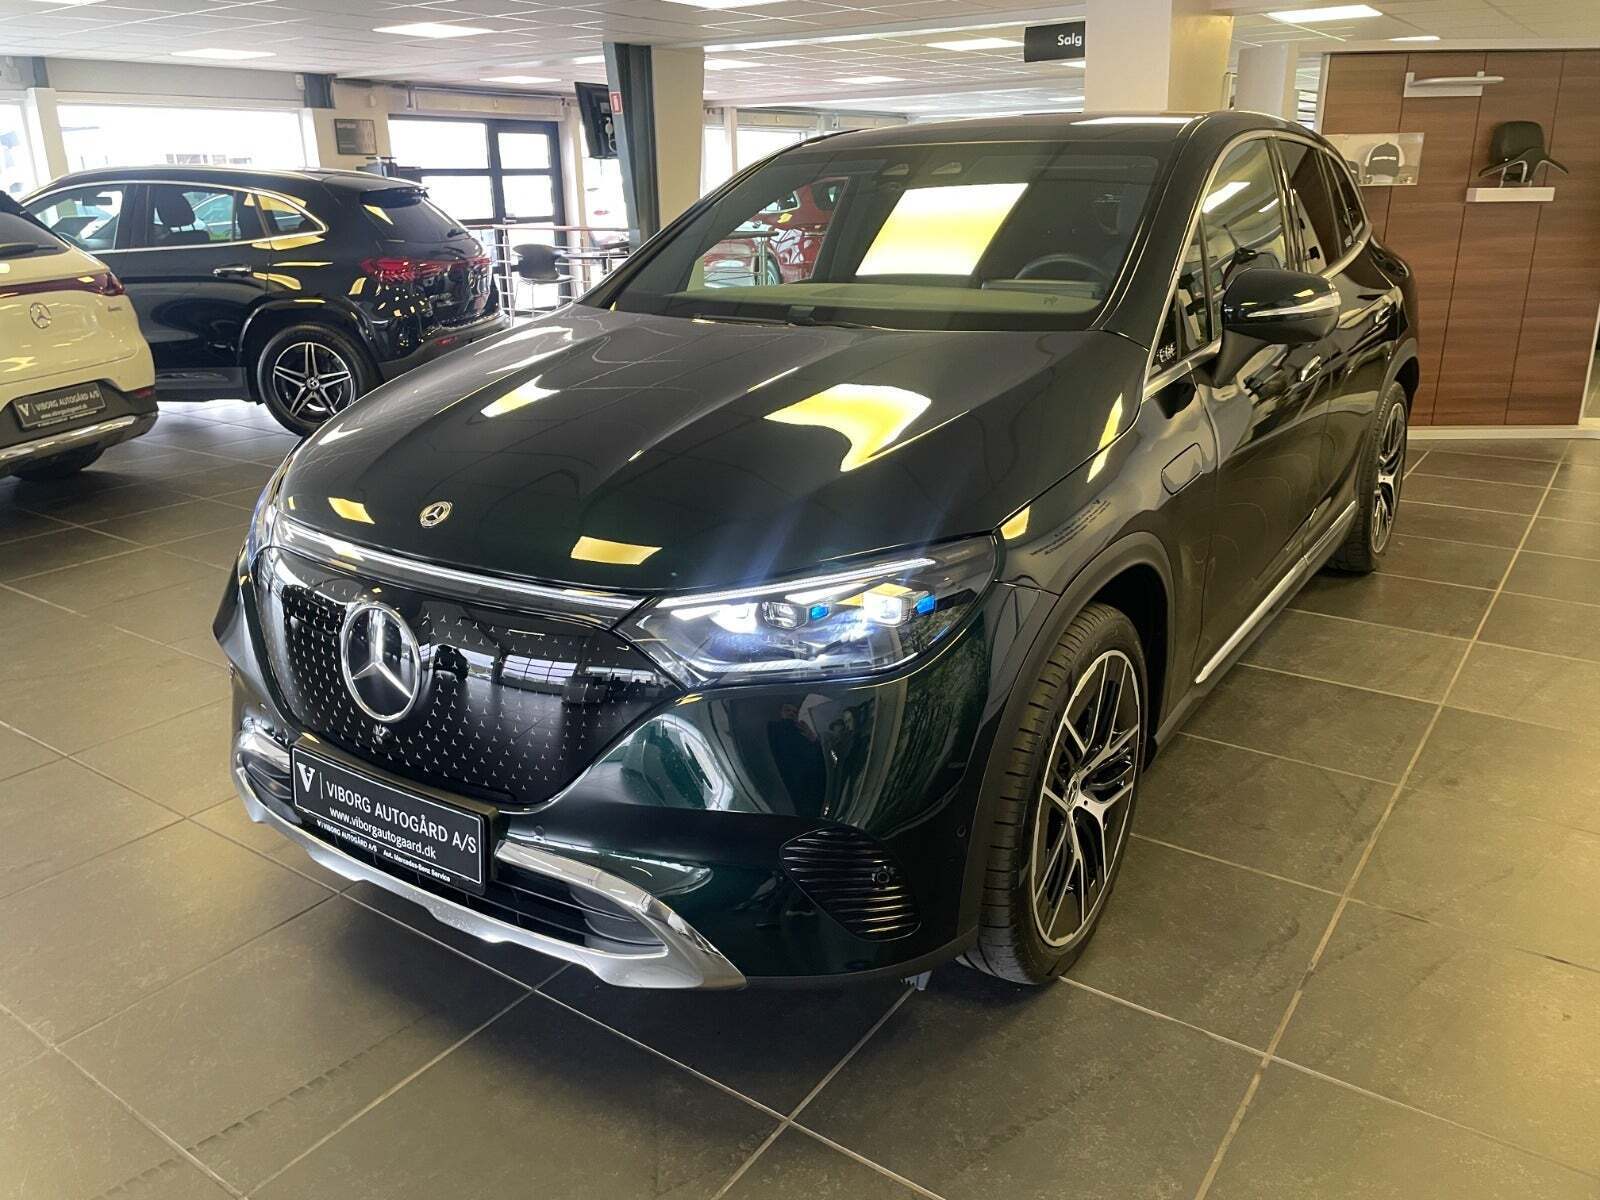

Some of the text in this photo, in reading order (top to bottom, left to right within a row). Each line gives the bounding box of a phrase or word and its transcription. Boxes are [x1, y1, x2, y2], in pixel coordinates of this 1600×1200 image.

[1057, 32, 1082, 47] Salg
[326, 780, 371, 813] VIBORG
[374, 802, 448, 842] AUTOGÅRD
[452, 830, 477, 854] A/S
[329, 806, 437, 860] www.viborgautogaard.dk
